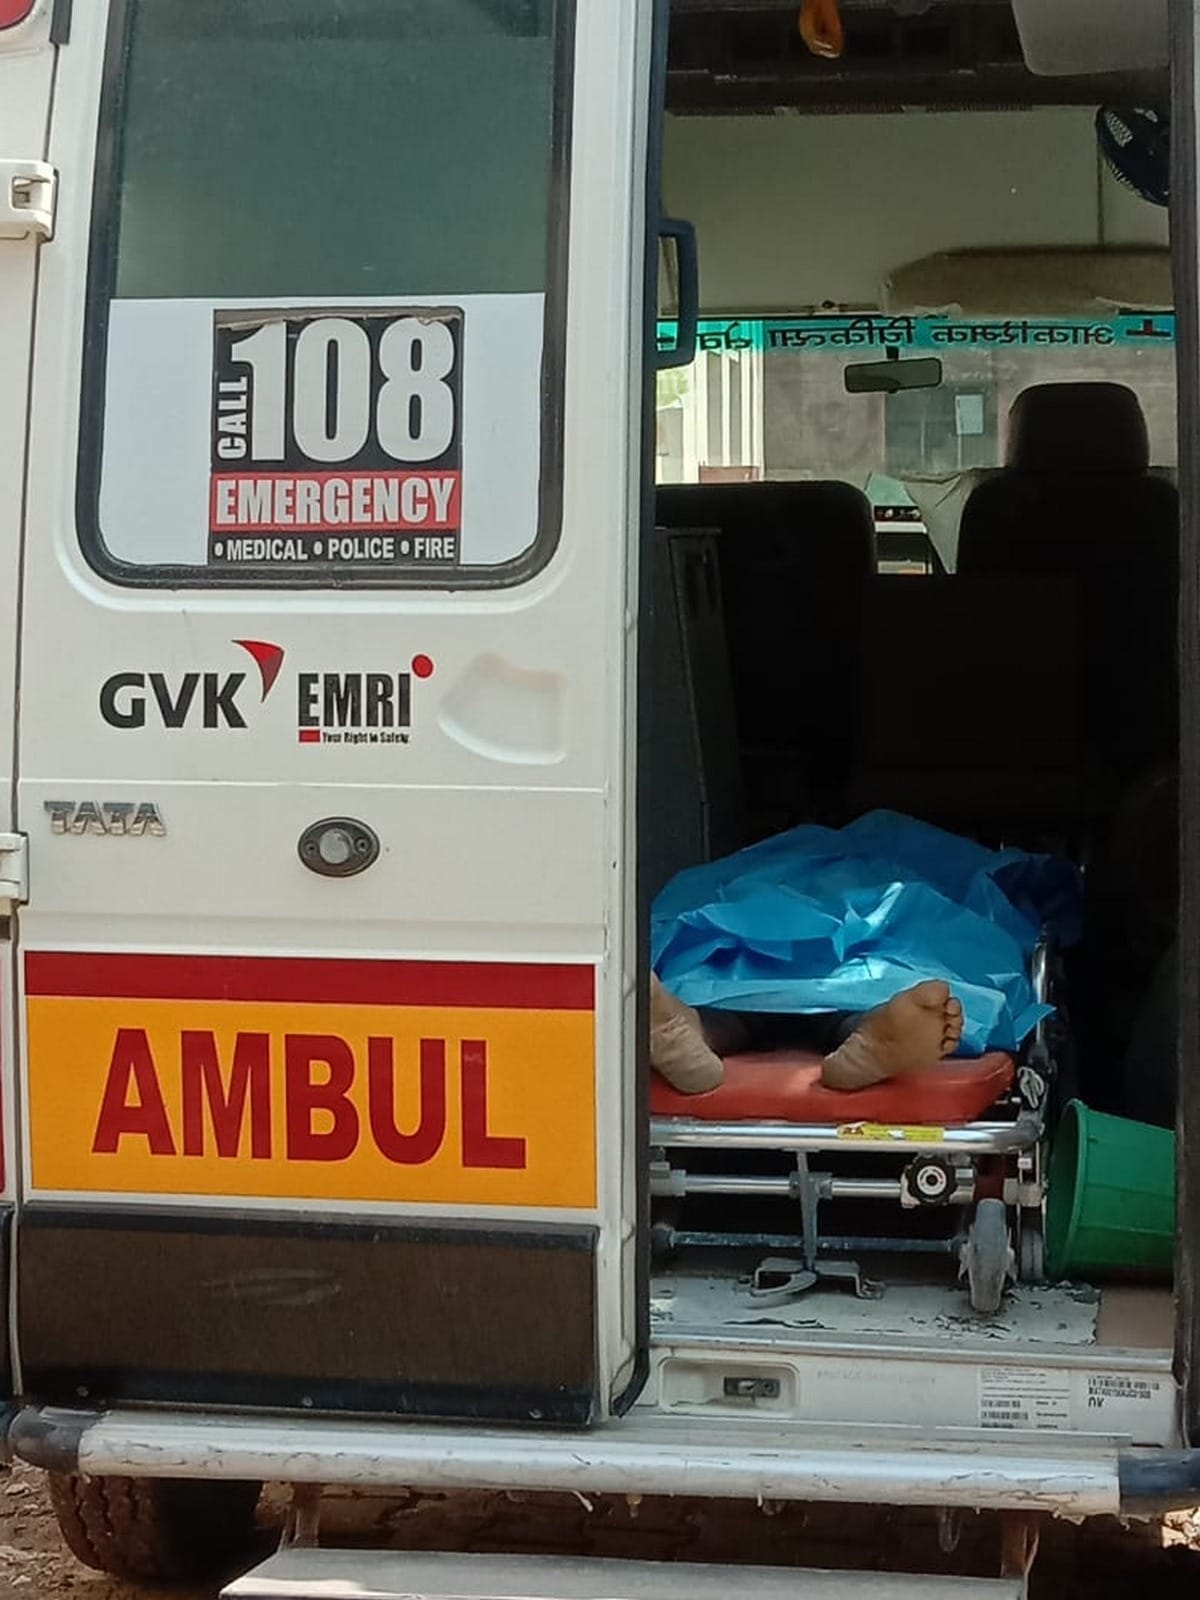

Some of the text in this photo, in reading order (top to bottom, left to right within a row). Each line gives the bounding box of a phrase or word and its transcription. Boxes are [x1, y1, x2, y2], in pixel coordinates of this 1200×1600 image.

[217, 376, 248, 459] CALL
[231, 317, 455, 463] 108
[216, 477, 456, 525] EMERGENCY
[226, 537, 455, 561] MEDICAL POLICE FIRE
[99, 672, 248, 729] GVK
[298, 673, 411, 727] EMRI
[44, 801, 167, 837] TATA
[92, 1028, 527, 1169] AMBUL
